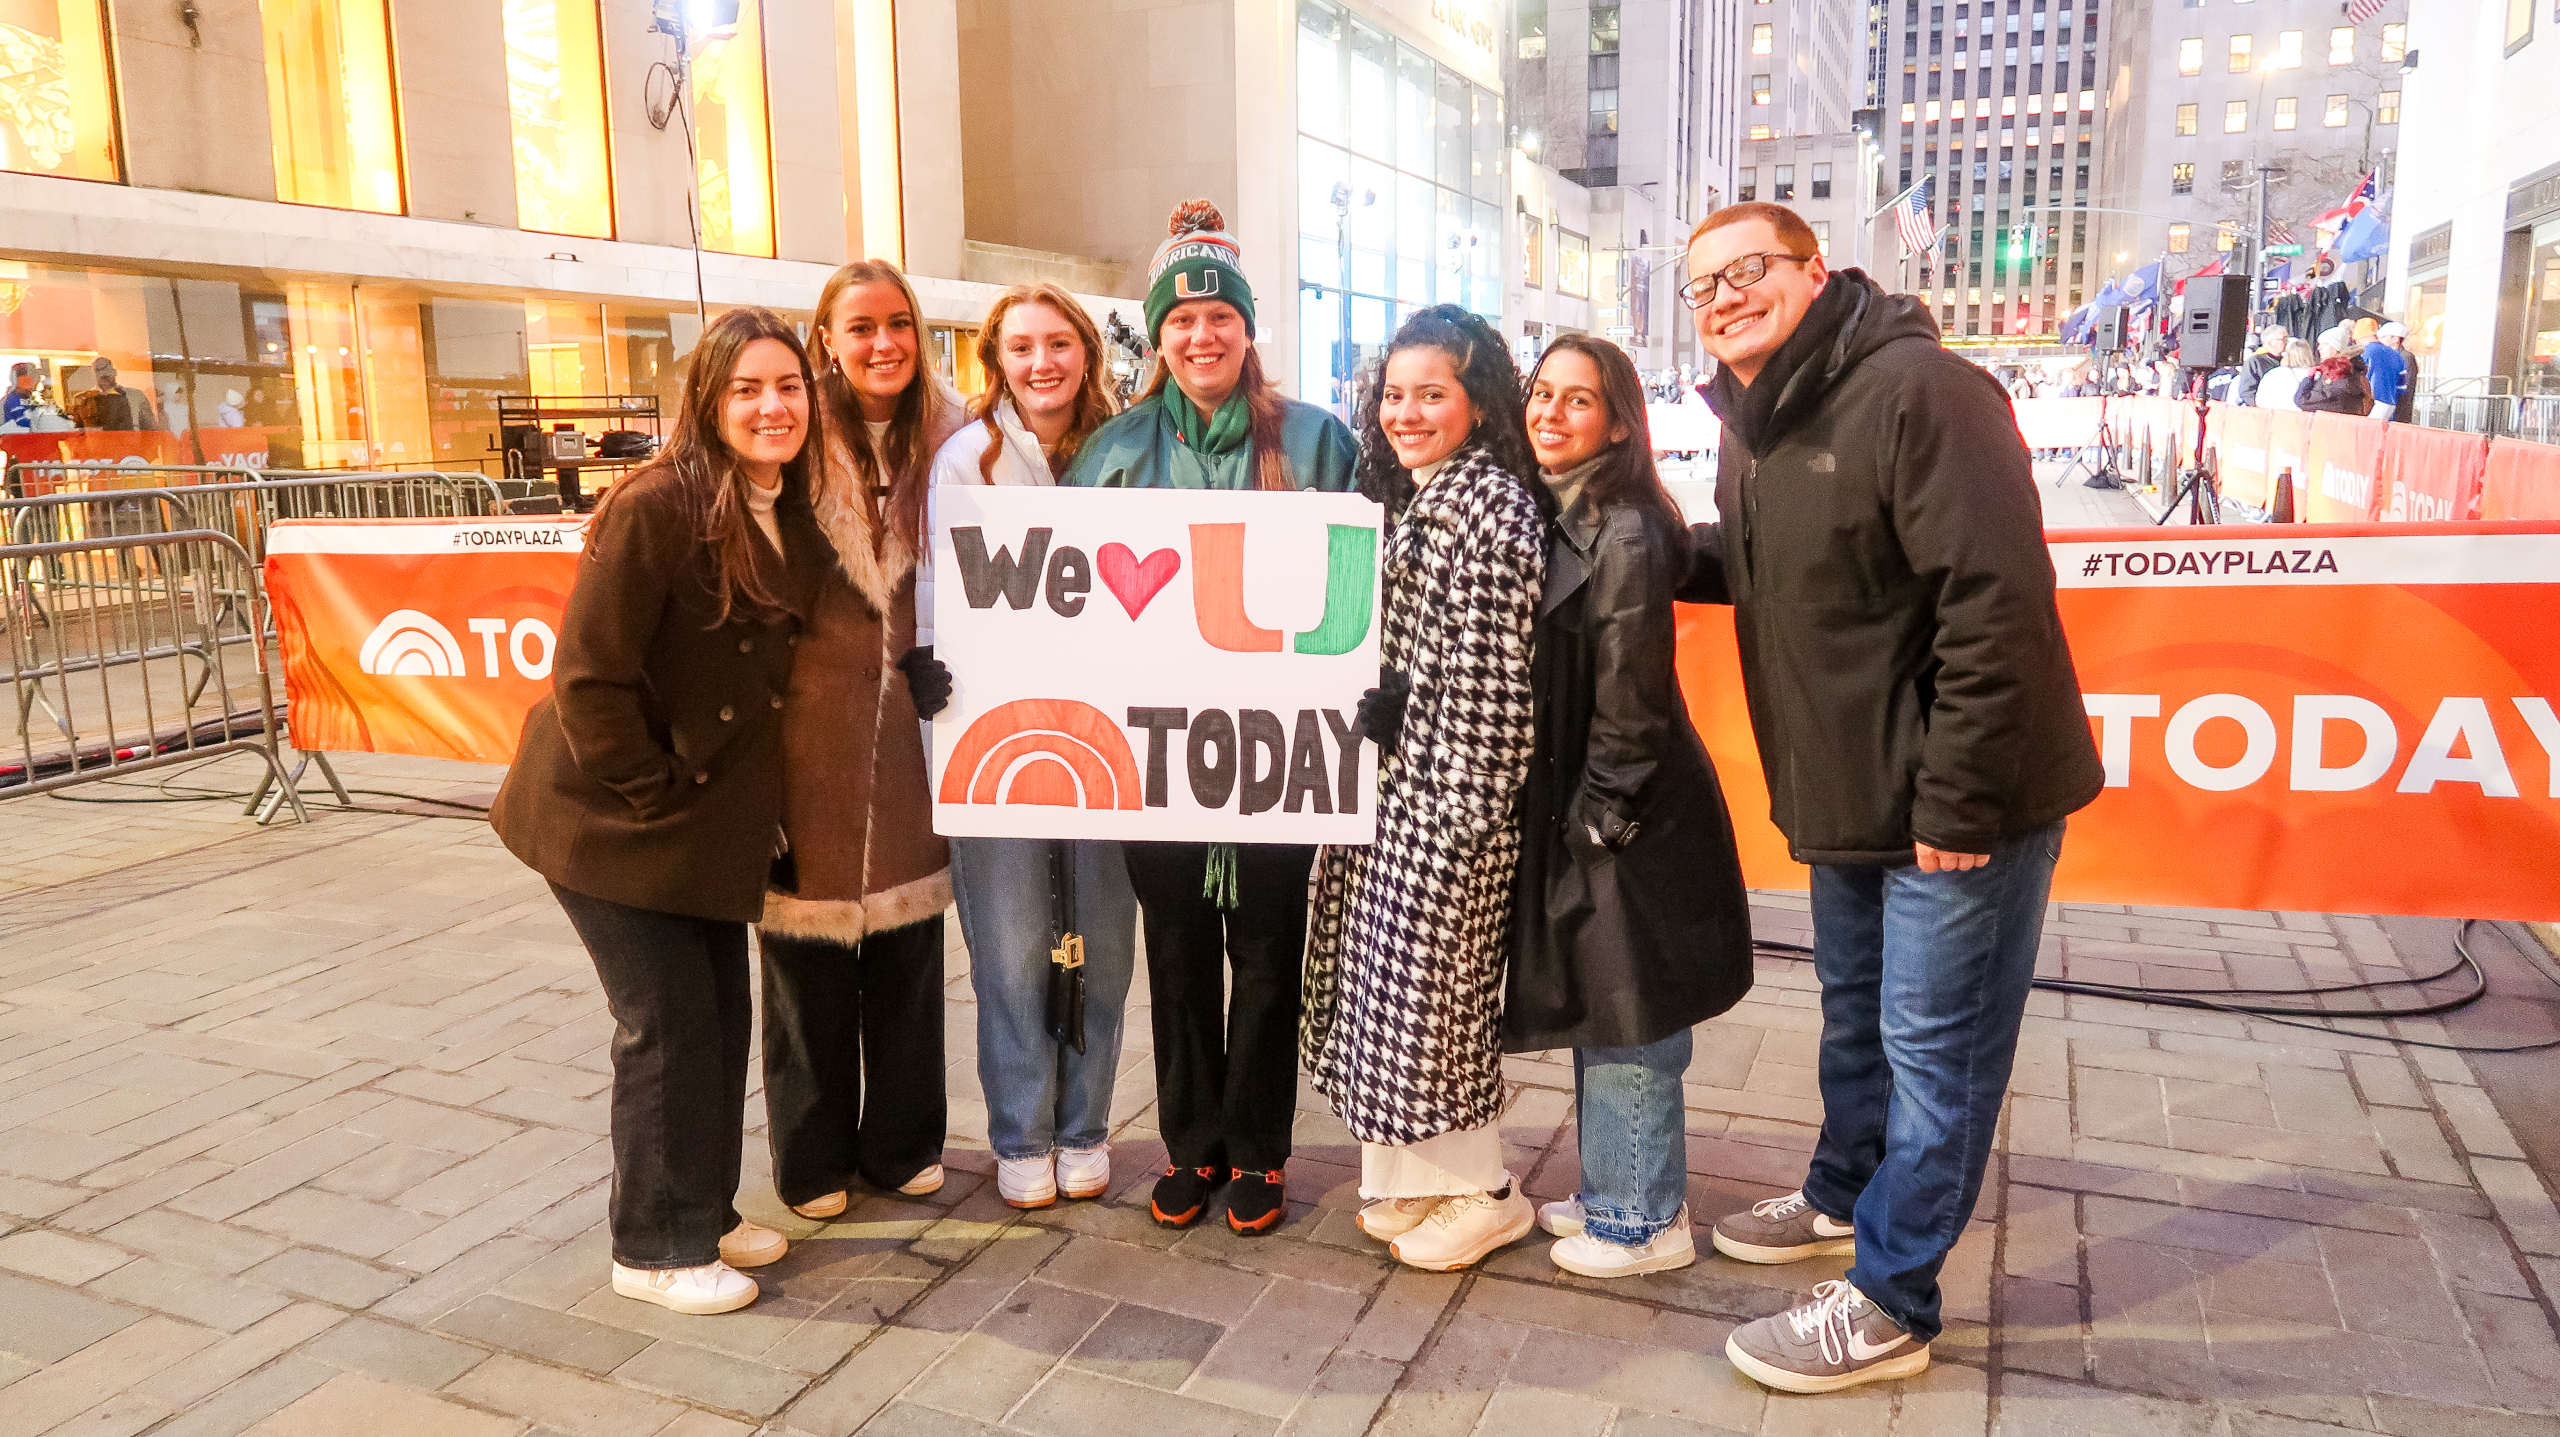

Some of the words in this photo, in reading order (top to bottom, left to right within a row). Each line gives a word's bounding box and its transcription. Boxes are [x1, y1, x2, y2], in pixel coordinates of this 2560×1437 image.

[1174, 269, 1219, 298] U
[2335, 468, 2369, 509] TODAY
[453, 530, 563, 547] #TODAYPLAZA
[2082, 550, 2339, 577] #TODAYPLAZA
[950, 526, 1091, 618] We
[1188, 522, 1377, 656] U
[1127, 706, 1366, 816] TODAY
